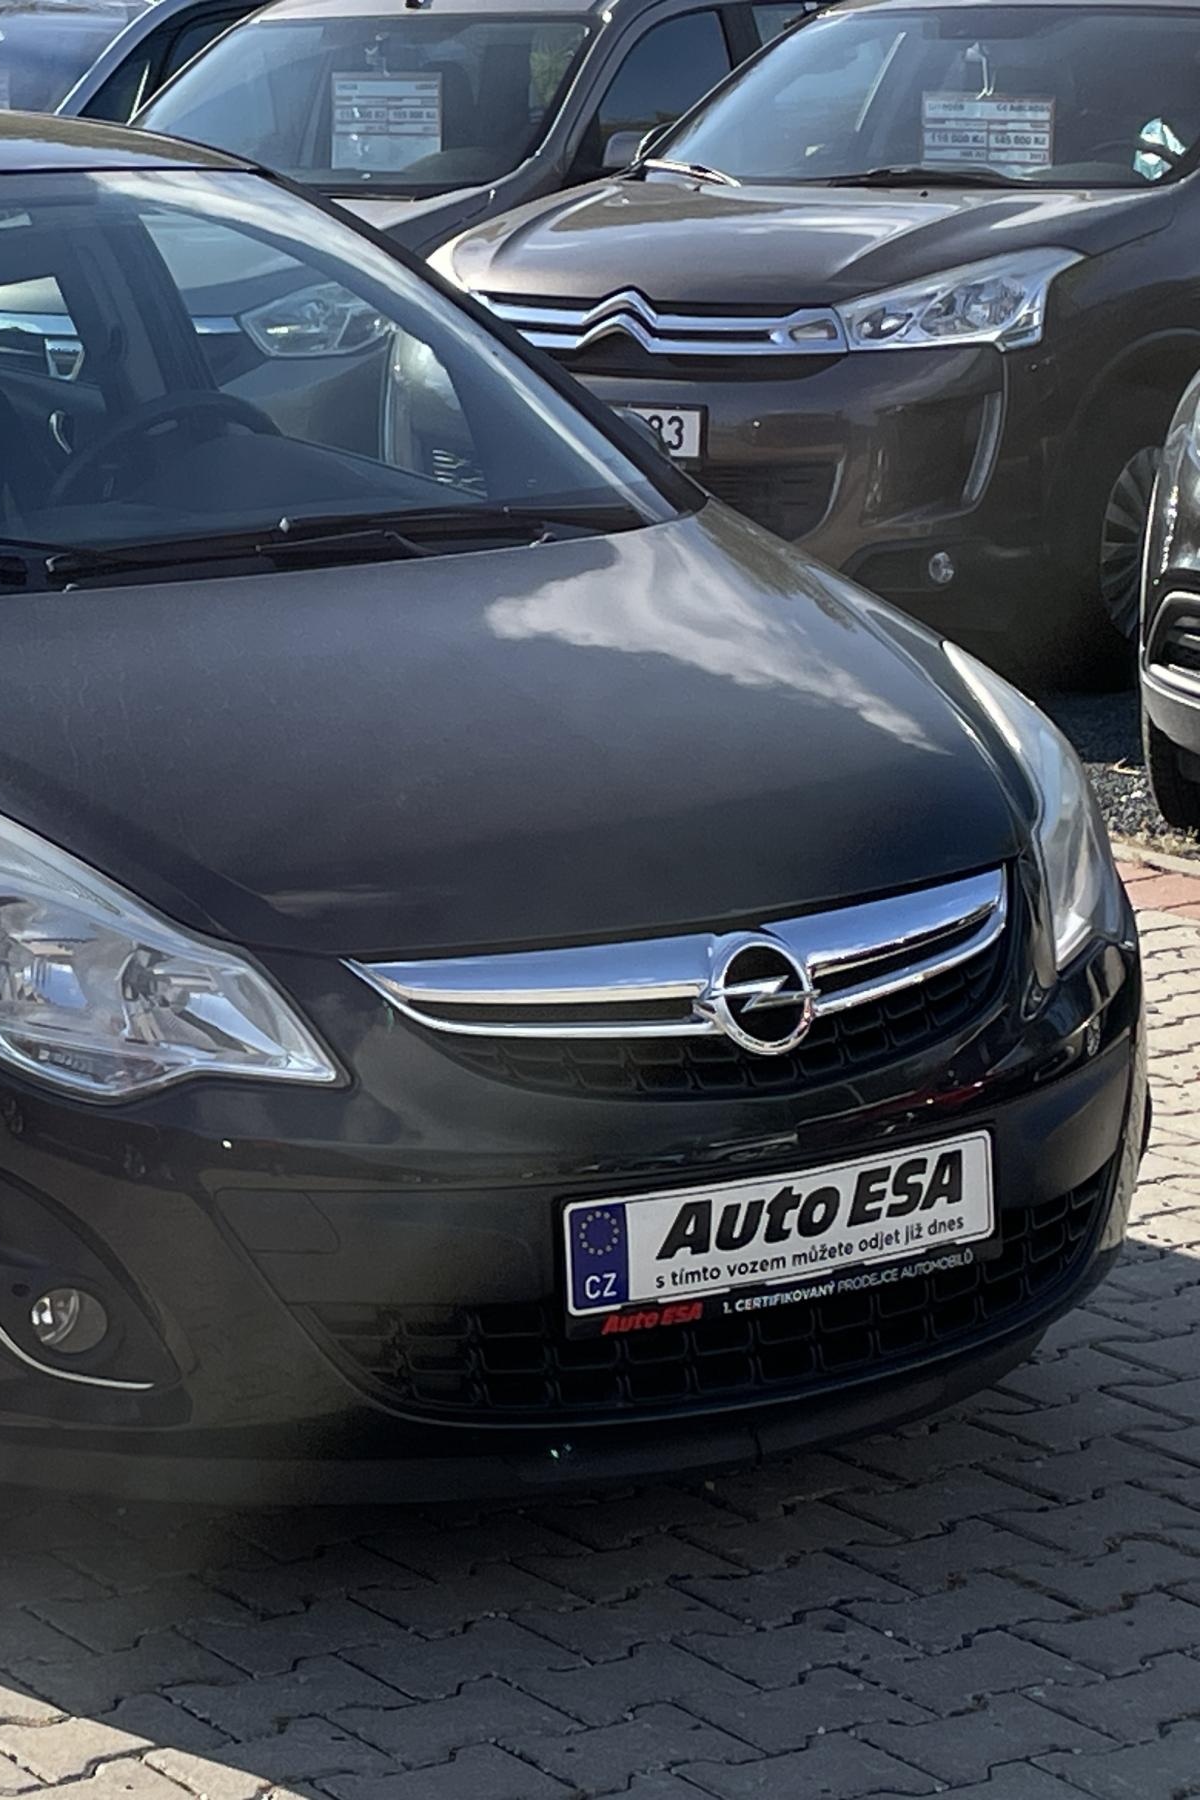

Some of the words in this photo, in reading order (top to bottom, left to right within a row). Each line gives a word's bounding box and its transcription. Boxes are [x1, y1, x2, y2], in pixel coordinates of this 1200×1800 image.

[656, 1186, 841, 1260] Auto
[847, 1150, 963, 1228] ESA
[656, 1276, 665, 1289] s
[671, 1263, 720, 1287] tímto
[726, 1254, 787, 1278] vozem
[792, 1242, 854, 1267] můžete
[858, 1230, 901, 1252] odjet
[905, 1223, 924, 1245] již
[927, 1215, 965, 1236] dnes
[734, 1281, 836, 1312] CERTIFIKOVANÝ
[837, 1268, 900, 1293] PRODEJCE
[901, 1249, 974, 1278] AUTOMOBILŮ
[584, 1272, 618, 1300] CZ
[601, 1309, 659, 1335] Auto
[659, 1302, 703, 1326] ESA
